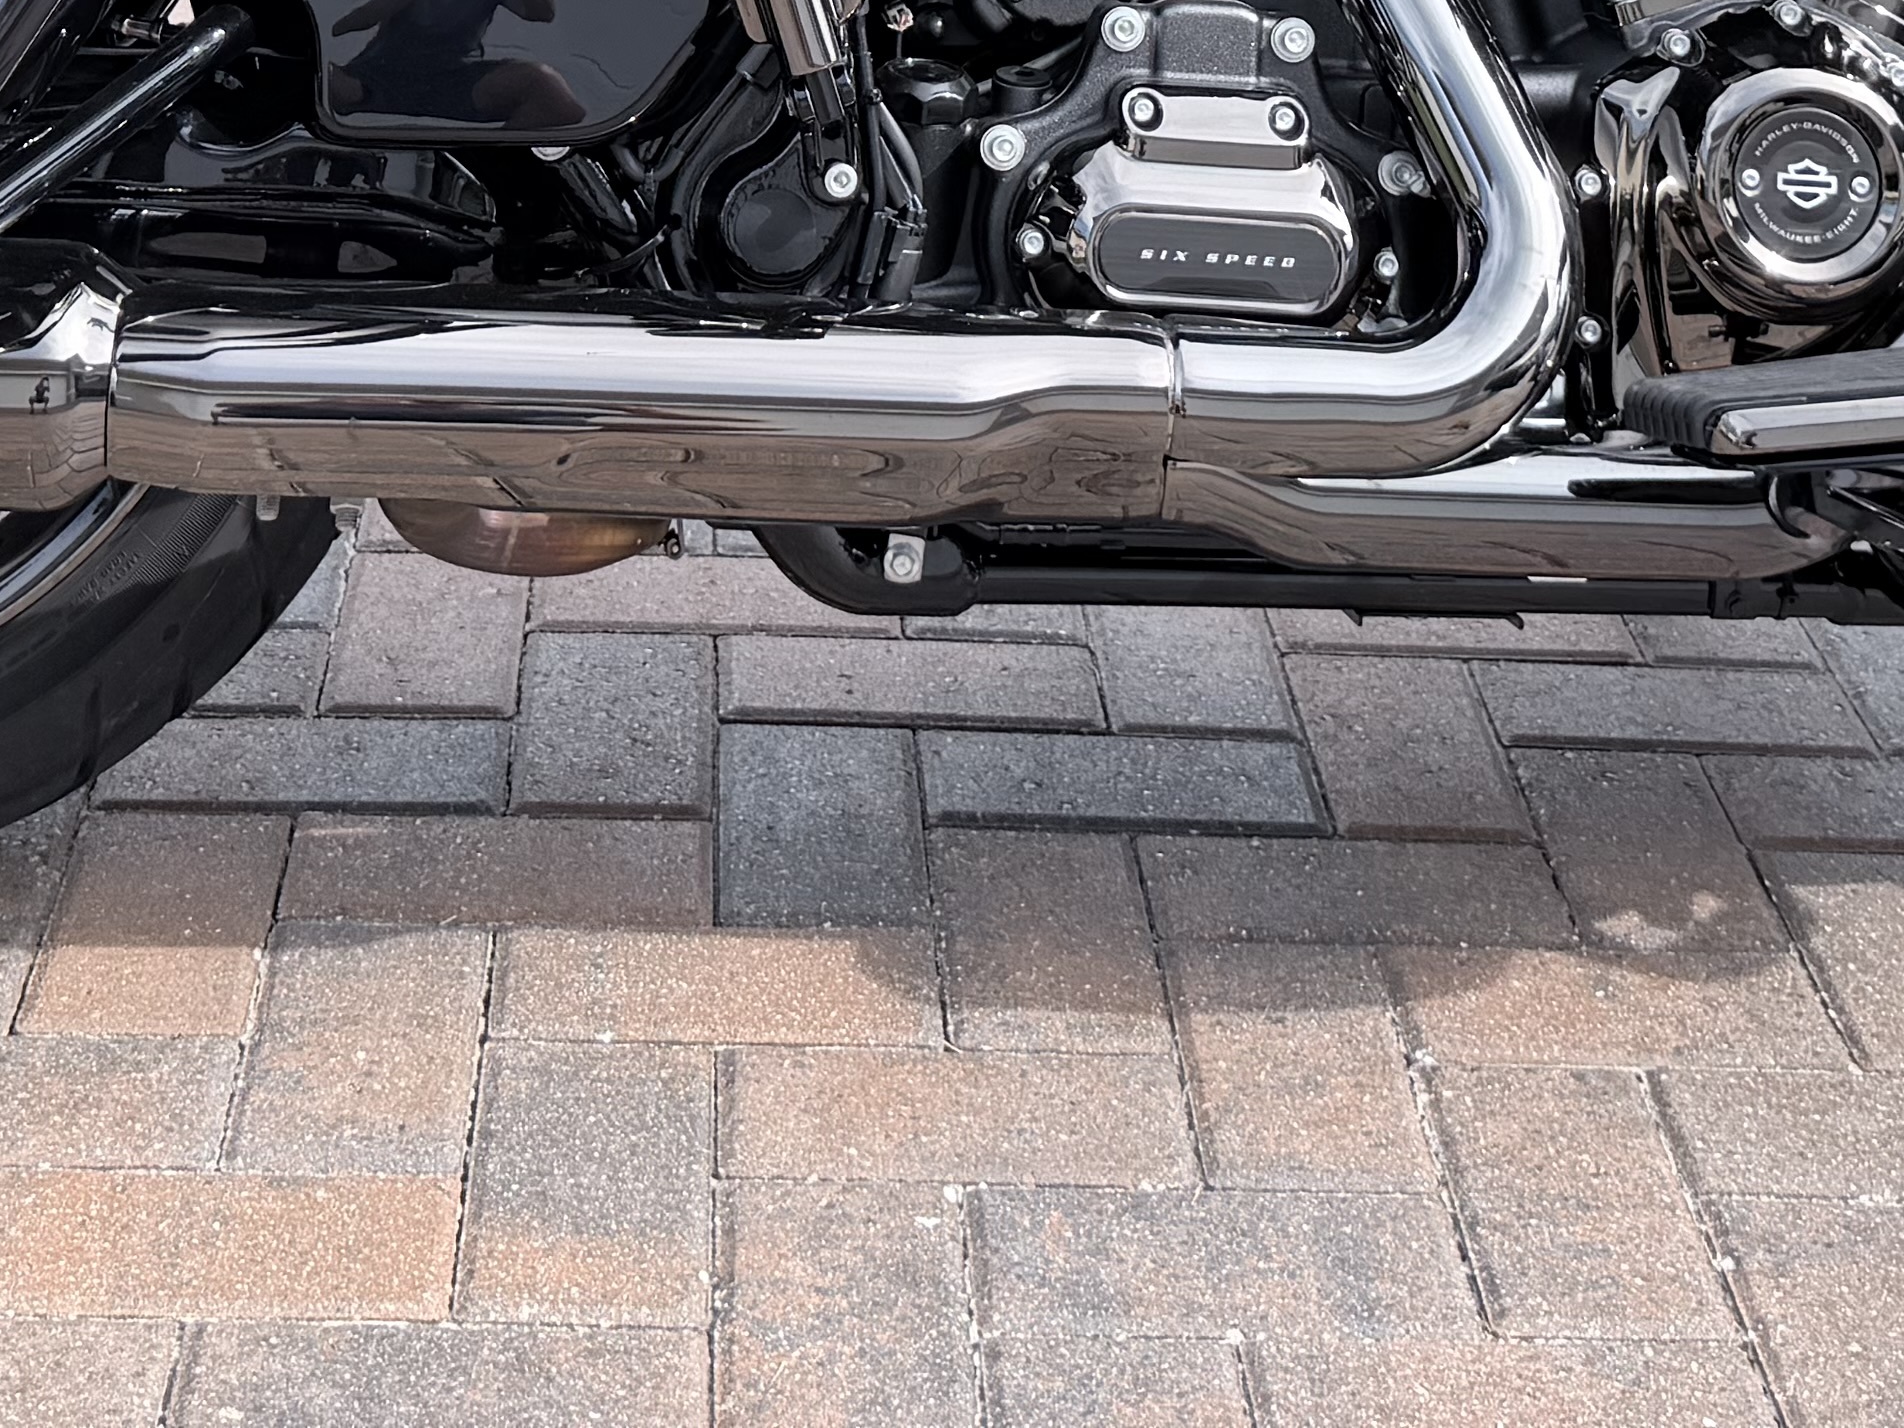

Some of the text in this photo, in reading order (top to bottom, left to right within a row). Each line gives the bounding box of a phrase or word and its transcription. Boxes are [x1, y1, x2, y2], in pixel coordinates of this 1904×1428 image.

[1754, 120, 1860, 164] HARLEY-DAVIDSON
[1140, 248, 1296, 268] SIX SPEED
